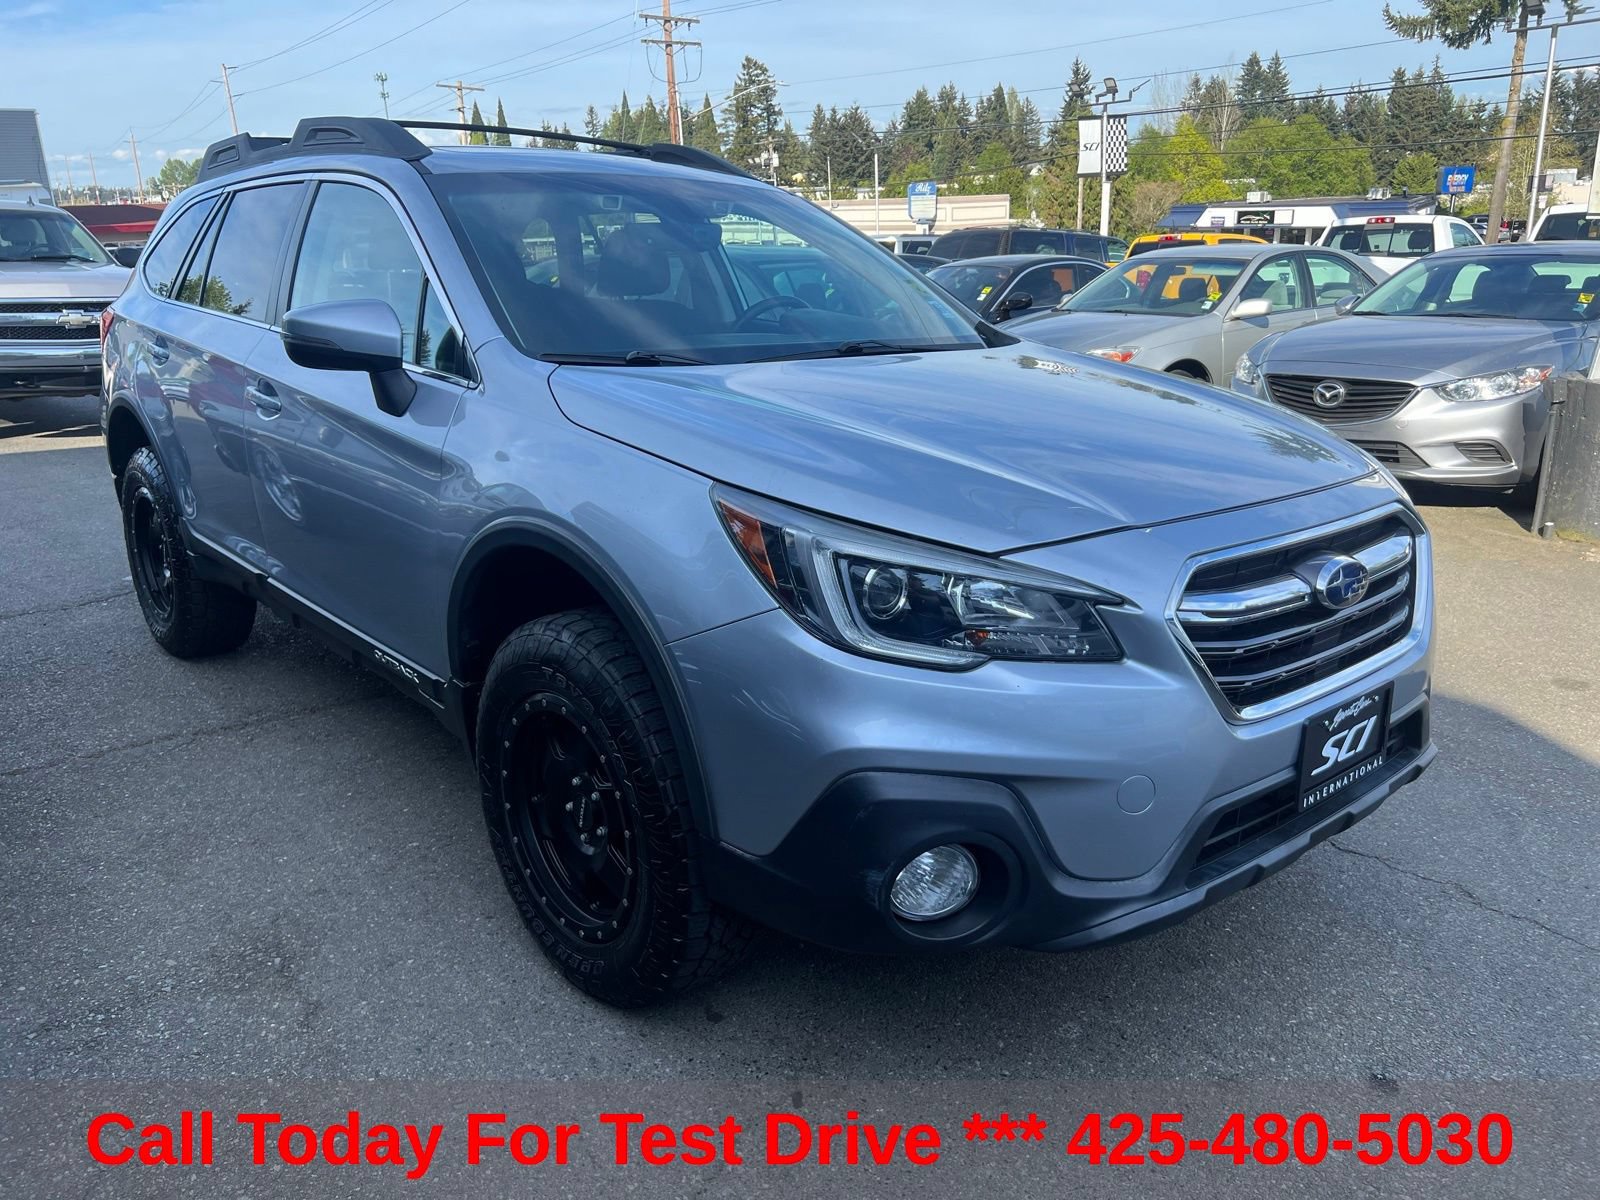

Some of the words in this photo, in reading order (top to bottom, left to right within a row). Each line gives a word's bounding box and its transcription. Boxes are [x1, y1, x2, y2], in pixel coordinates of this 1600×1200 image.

[1081, 142, 1100, 151] SCI
[1311, 715, 1377, 776] SCI
[1303, 756, 1383, 807] INTERNATIONAL
